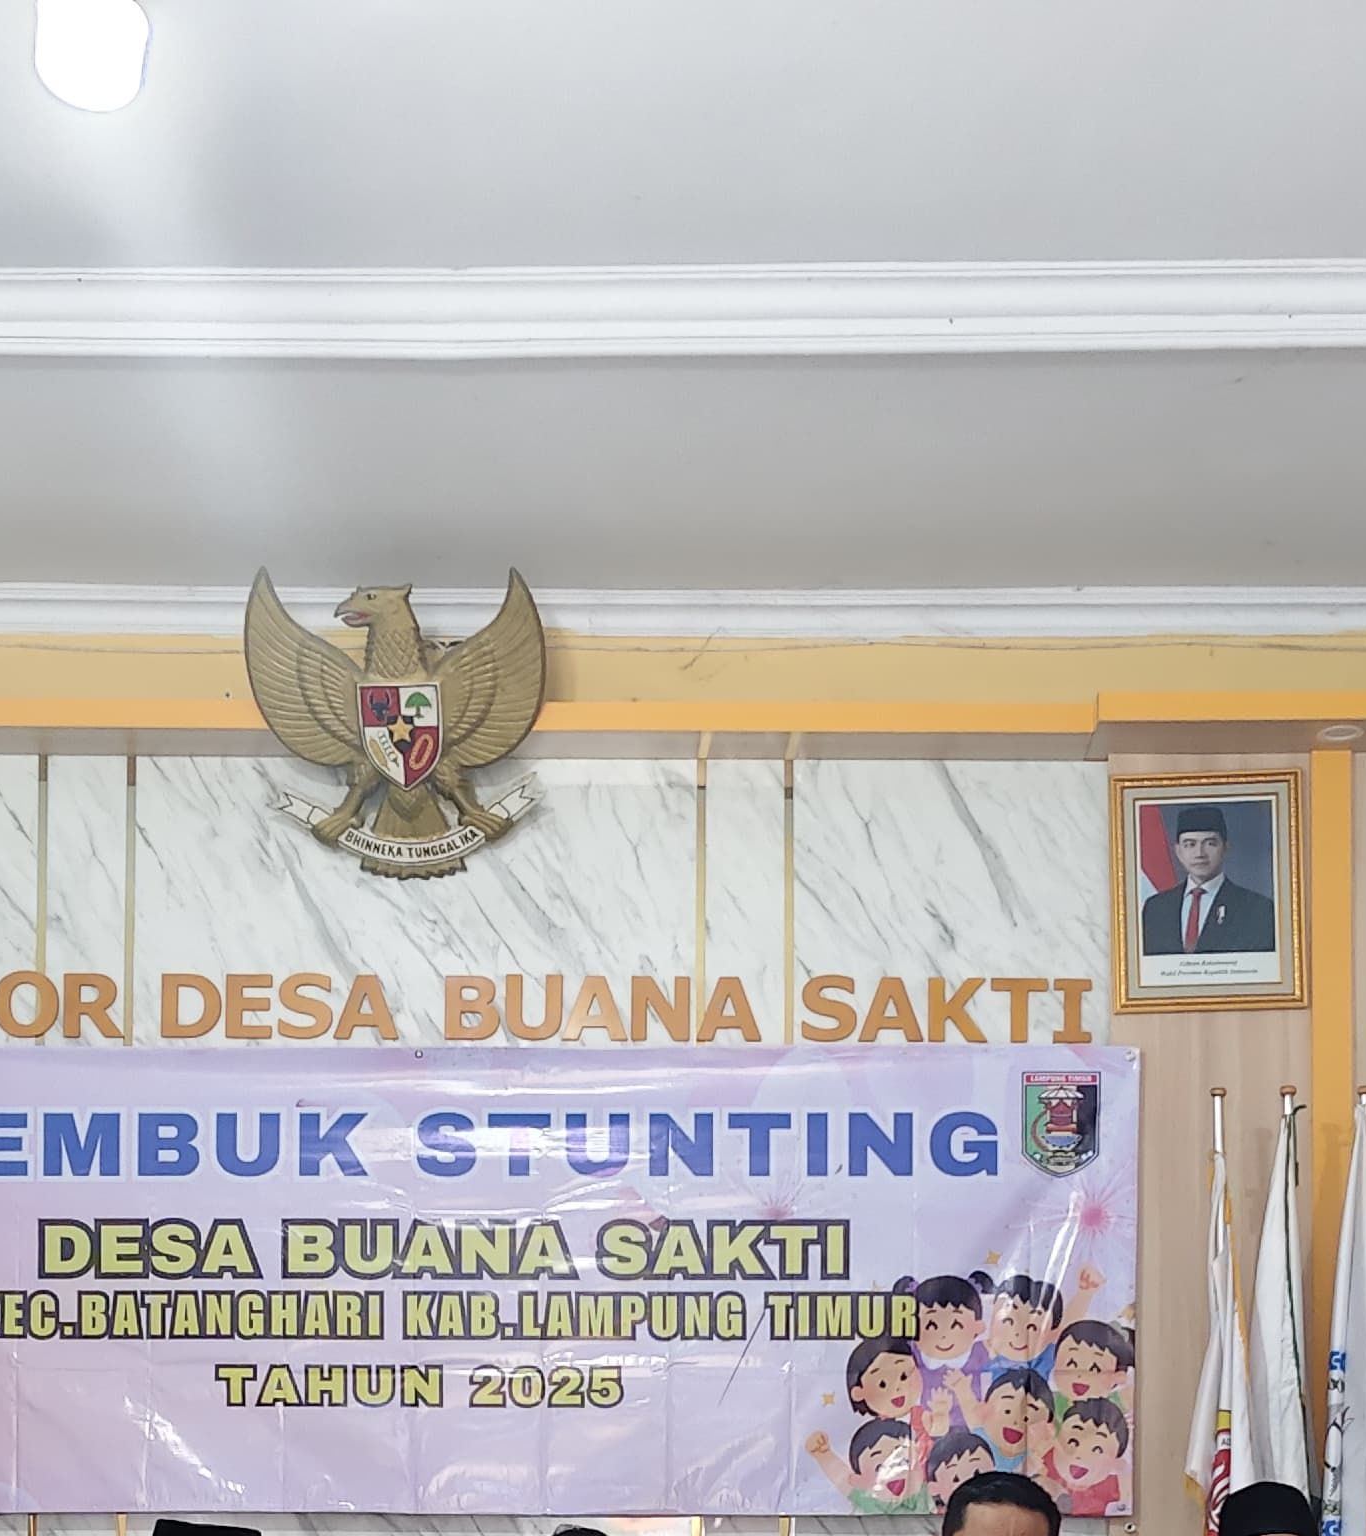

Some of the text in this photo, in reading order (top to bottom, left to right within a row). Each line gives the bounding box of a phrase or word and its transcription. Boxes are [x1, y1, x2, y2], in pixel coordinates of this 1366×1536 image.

[344, 829, 479, 858] BHINNEKA TUNGGAL IKA
[161, 972, 398, 1040] DESA
[444, 974, 761, 1042] BUANA
[801, 976, 1092, 1043] SAKTI
[415, 1112, 999, 1178] STUNTING
[37, 1216, 851, 1282] DESA BUANA SAKTI
[401, 1291, 747, 1341] KAB.LAMPUNG
[764, 1291, 920, 1342] TIMUR
[214, 1364, 625, 1410] TAHUN 2025
